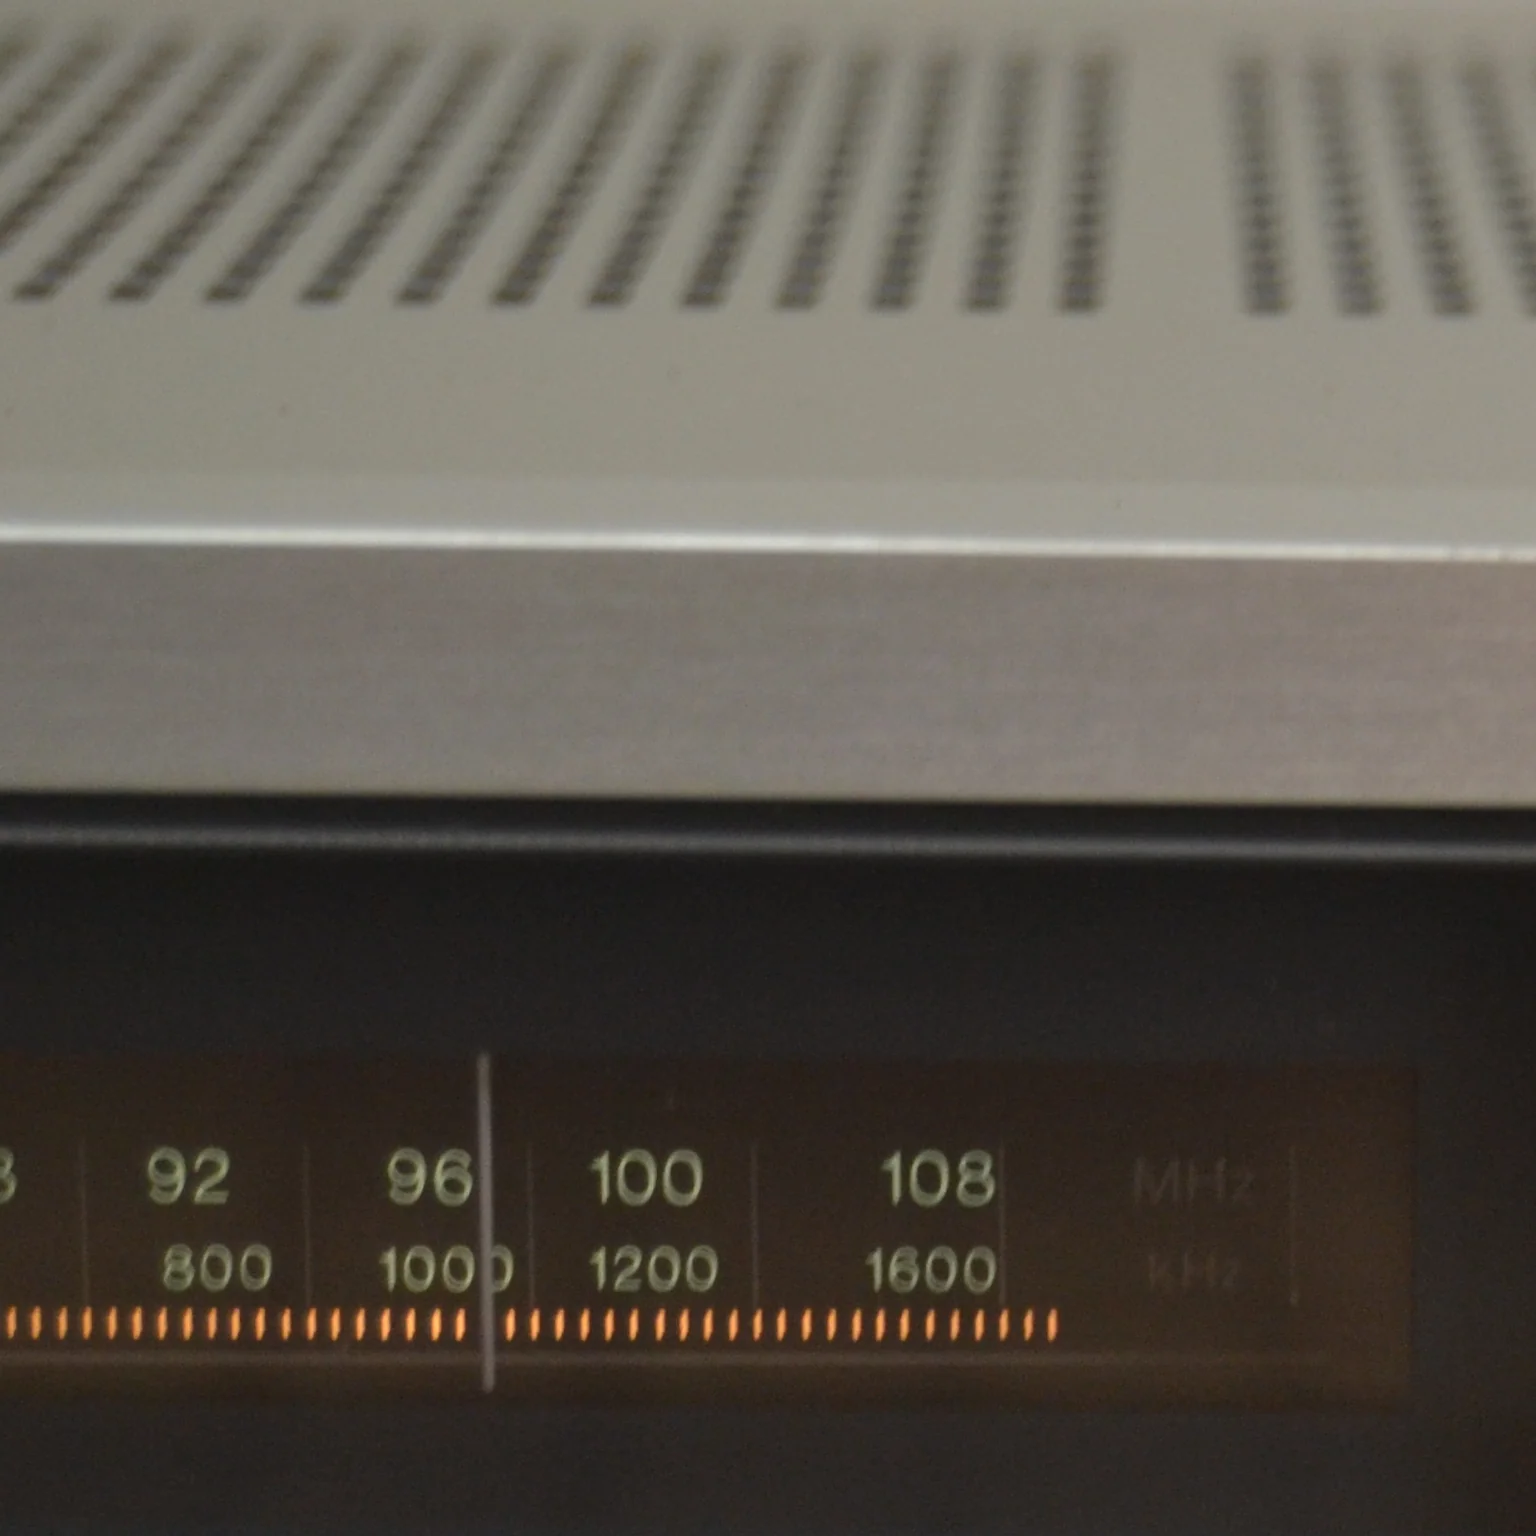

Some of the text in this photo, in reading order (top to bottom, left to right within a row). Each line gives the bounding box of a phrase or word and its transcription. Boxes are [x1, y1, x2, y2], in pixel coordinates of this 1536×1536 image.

[147, 1147, 232, 1206] 92
[387, 1148, 475, 1207] 96
[591, 1149, 706, 1208] 100
[883, 1149, 998, 1209] 108
[162, 1244, 275, 1293] 800
[378, 1244, 516, 1294] 1000
[590, 1244, 721, 1294] 1200
[867, 1246, 999, 1295] 1600
